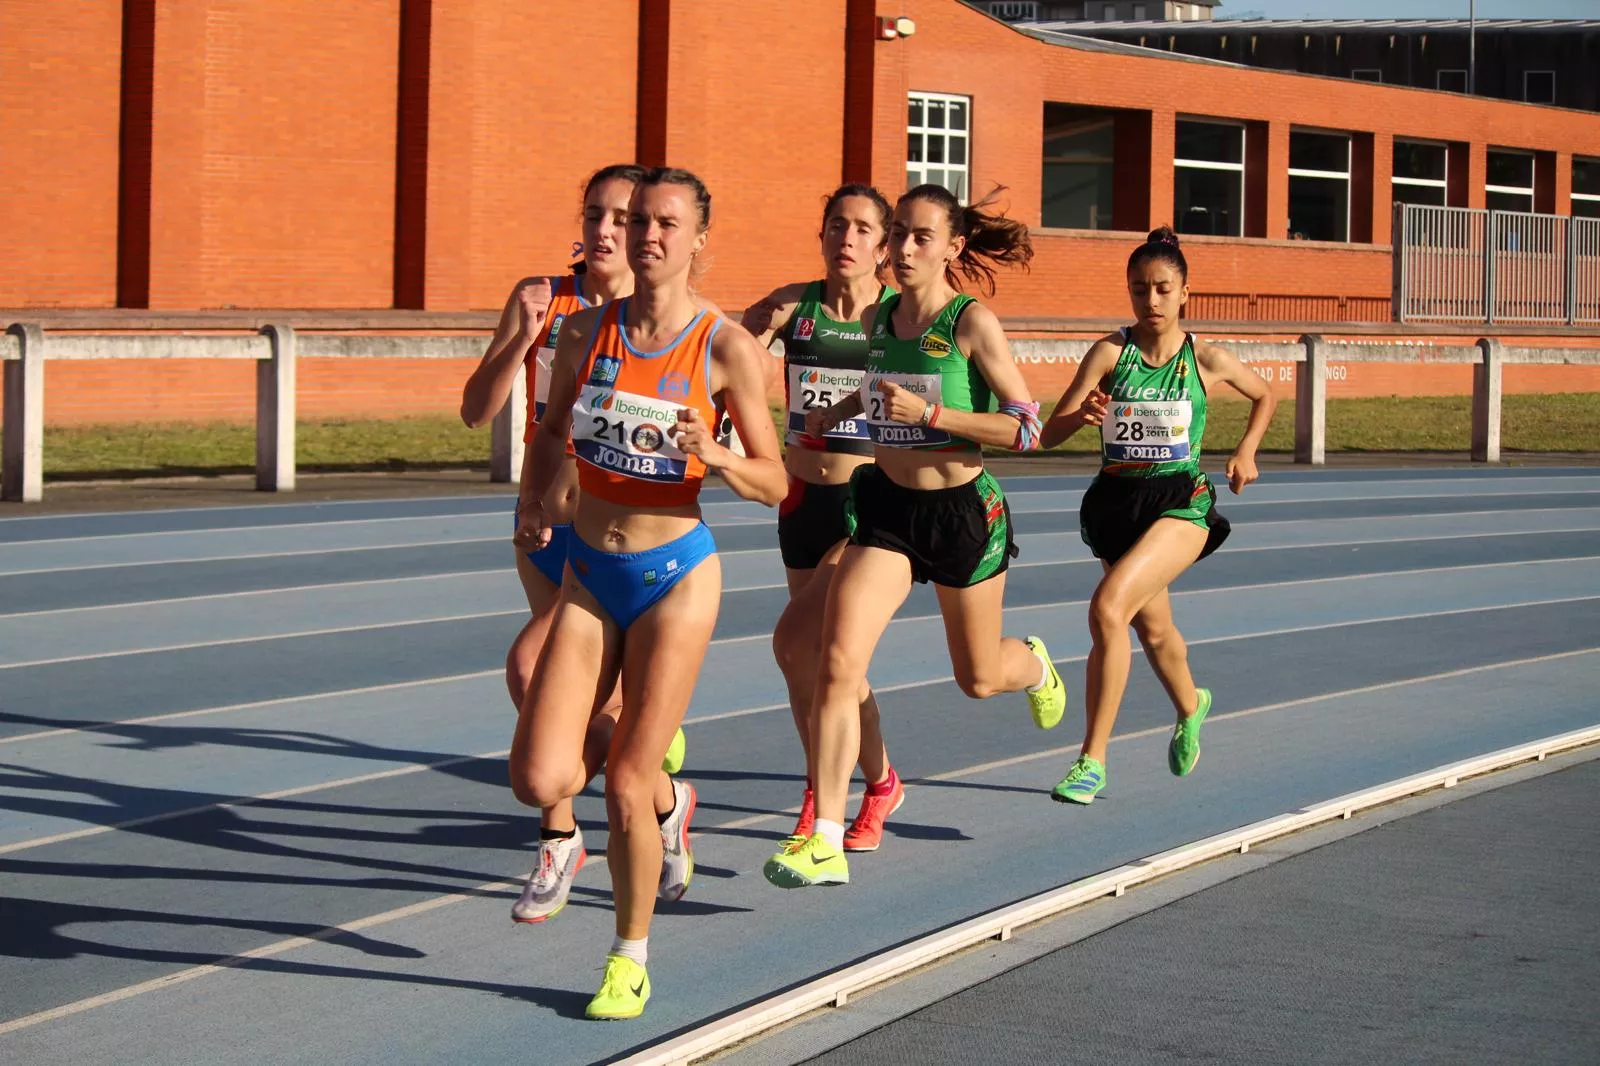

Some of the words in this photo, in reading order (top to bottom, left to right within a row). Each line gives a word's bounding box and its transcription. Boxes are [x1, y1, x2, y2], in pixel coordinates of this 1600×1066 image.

[1279, 366, 1293, 381] DE
[801, 389, 832, 410] 25
[614, 399, 677, 424] Iberdrola
[1133, 407, 1180, 417] Iberdrola
[592, 416, 625, 444] 21
[1115, 421, 1144, 441] 28
